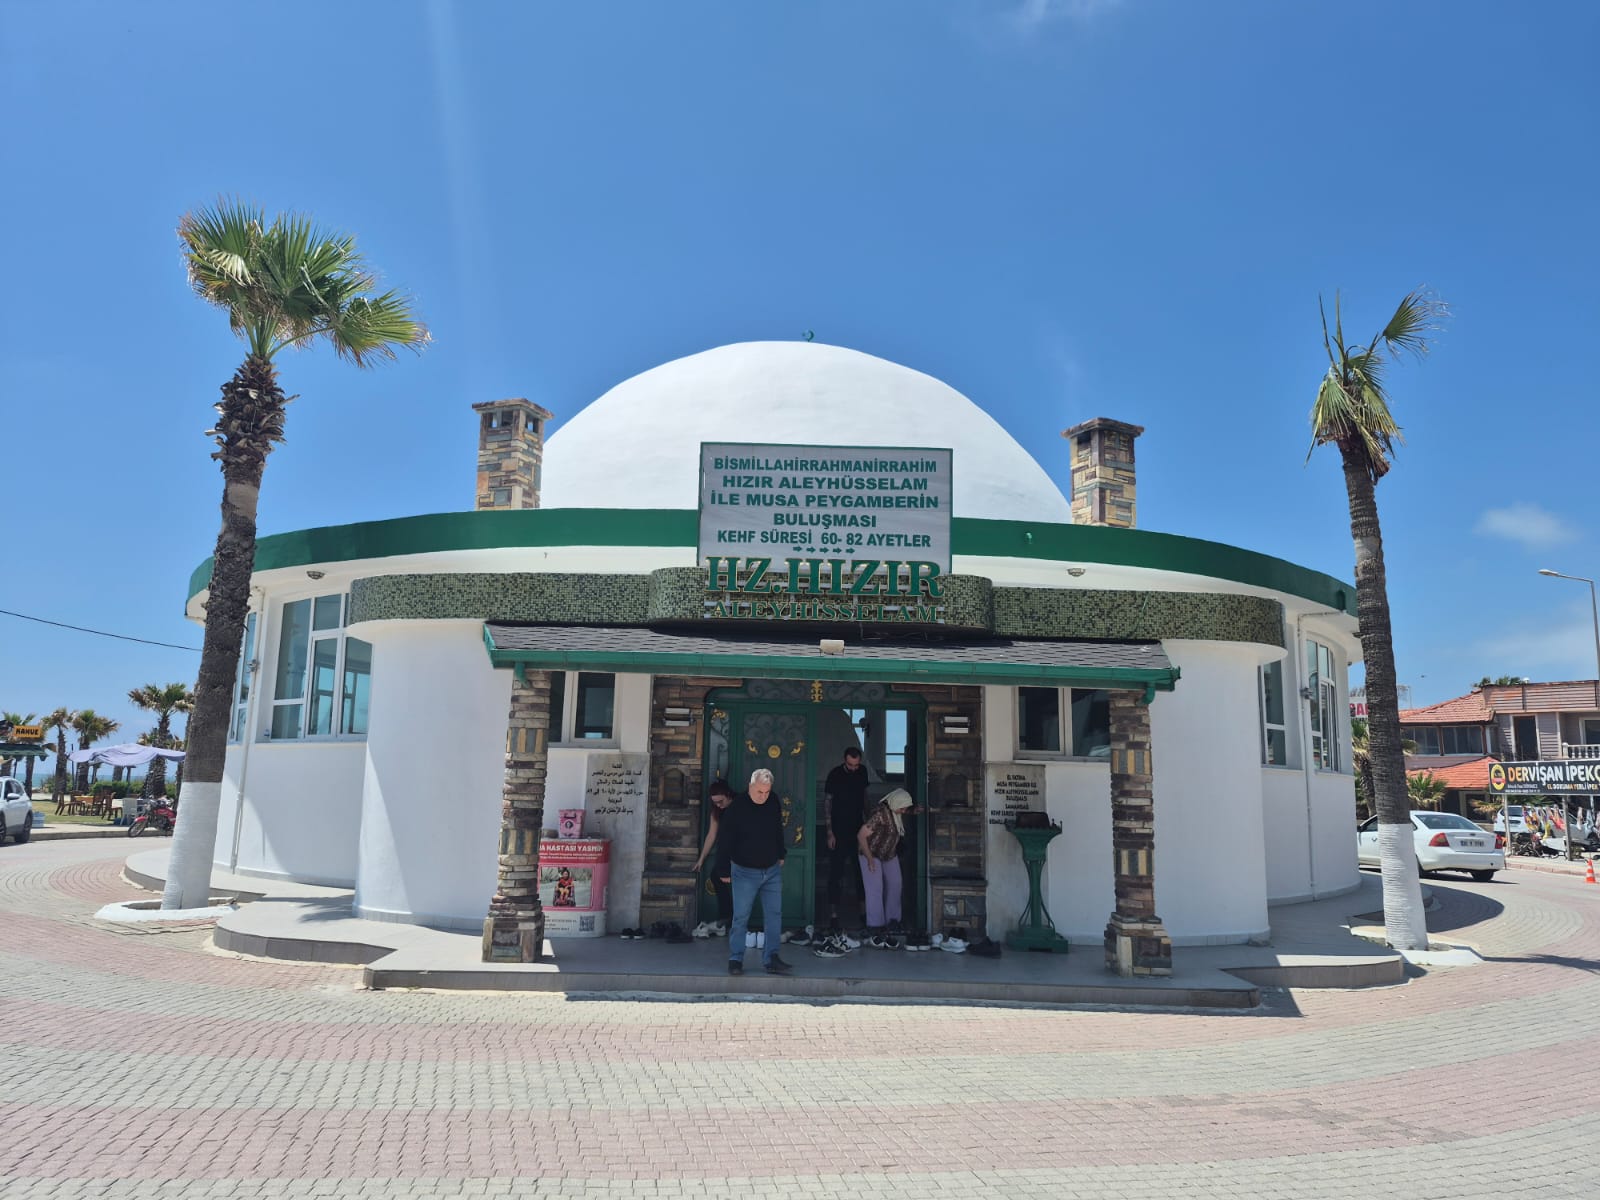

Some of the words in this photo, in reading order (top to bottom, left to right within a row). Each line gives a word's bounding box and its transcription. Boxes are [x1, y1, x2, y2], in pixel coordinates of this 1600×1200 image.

[714, 457, 937, 473] BİSMİLLAHİRRAHMANİRRAHİM
[723, 475, 773, 488] HIZIR
[778, 475, 928, 490] ALEYHÜSSELAM
[710, 490, 740, 505] İLE
[746, 494, 799, 507] MUSA
[805, 493, 939, 508] PEYGAMBERİN
[773, 513, 877, 529] BULUŞMASI
[717, 530, 756, 543] KEHF
[760, 529, 812, 544] SÜRESİ
[846, 533, 863, 546] 82
[866, 533, 931, 547] AYETLER
[705, 556, 945, 597] HZ.HIZIR
[711, 598, 937, 622] ALEYHİSSELAM
[1507, 762, 1563, 786] DERVİŞAN
